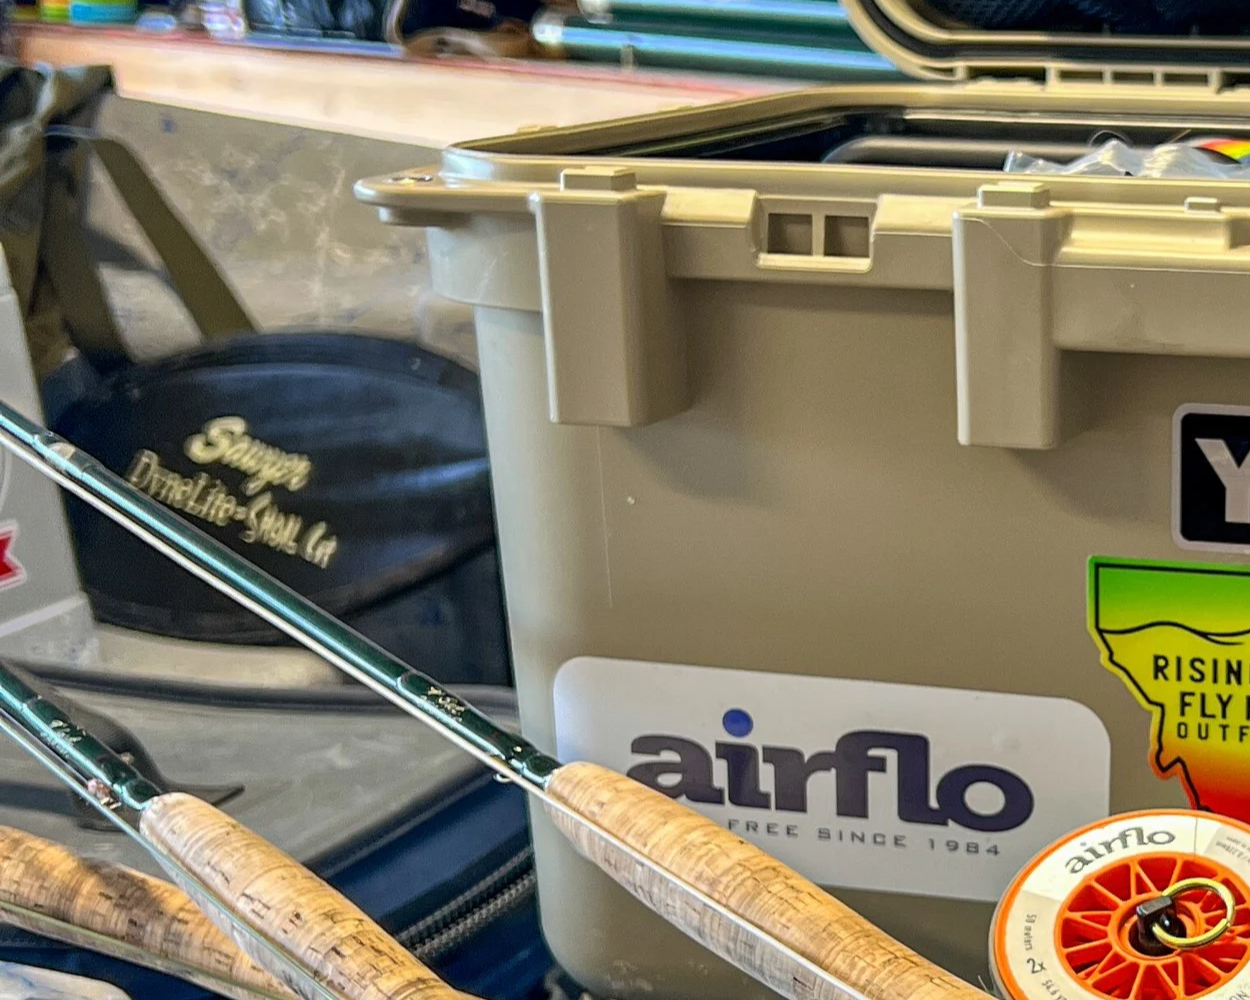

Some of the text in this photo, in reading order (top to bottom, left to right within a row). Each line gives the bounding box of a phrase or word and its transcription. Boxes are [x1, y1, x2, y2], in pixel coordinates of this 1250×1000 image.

[1179, 690, 1234, 720] FLY
[626, 706, 1035, 834] airflo
[727, 818, 1001, 857] FREE SINCE 1984
[1064, 826, 1176, 874] airflo
